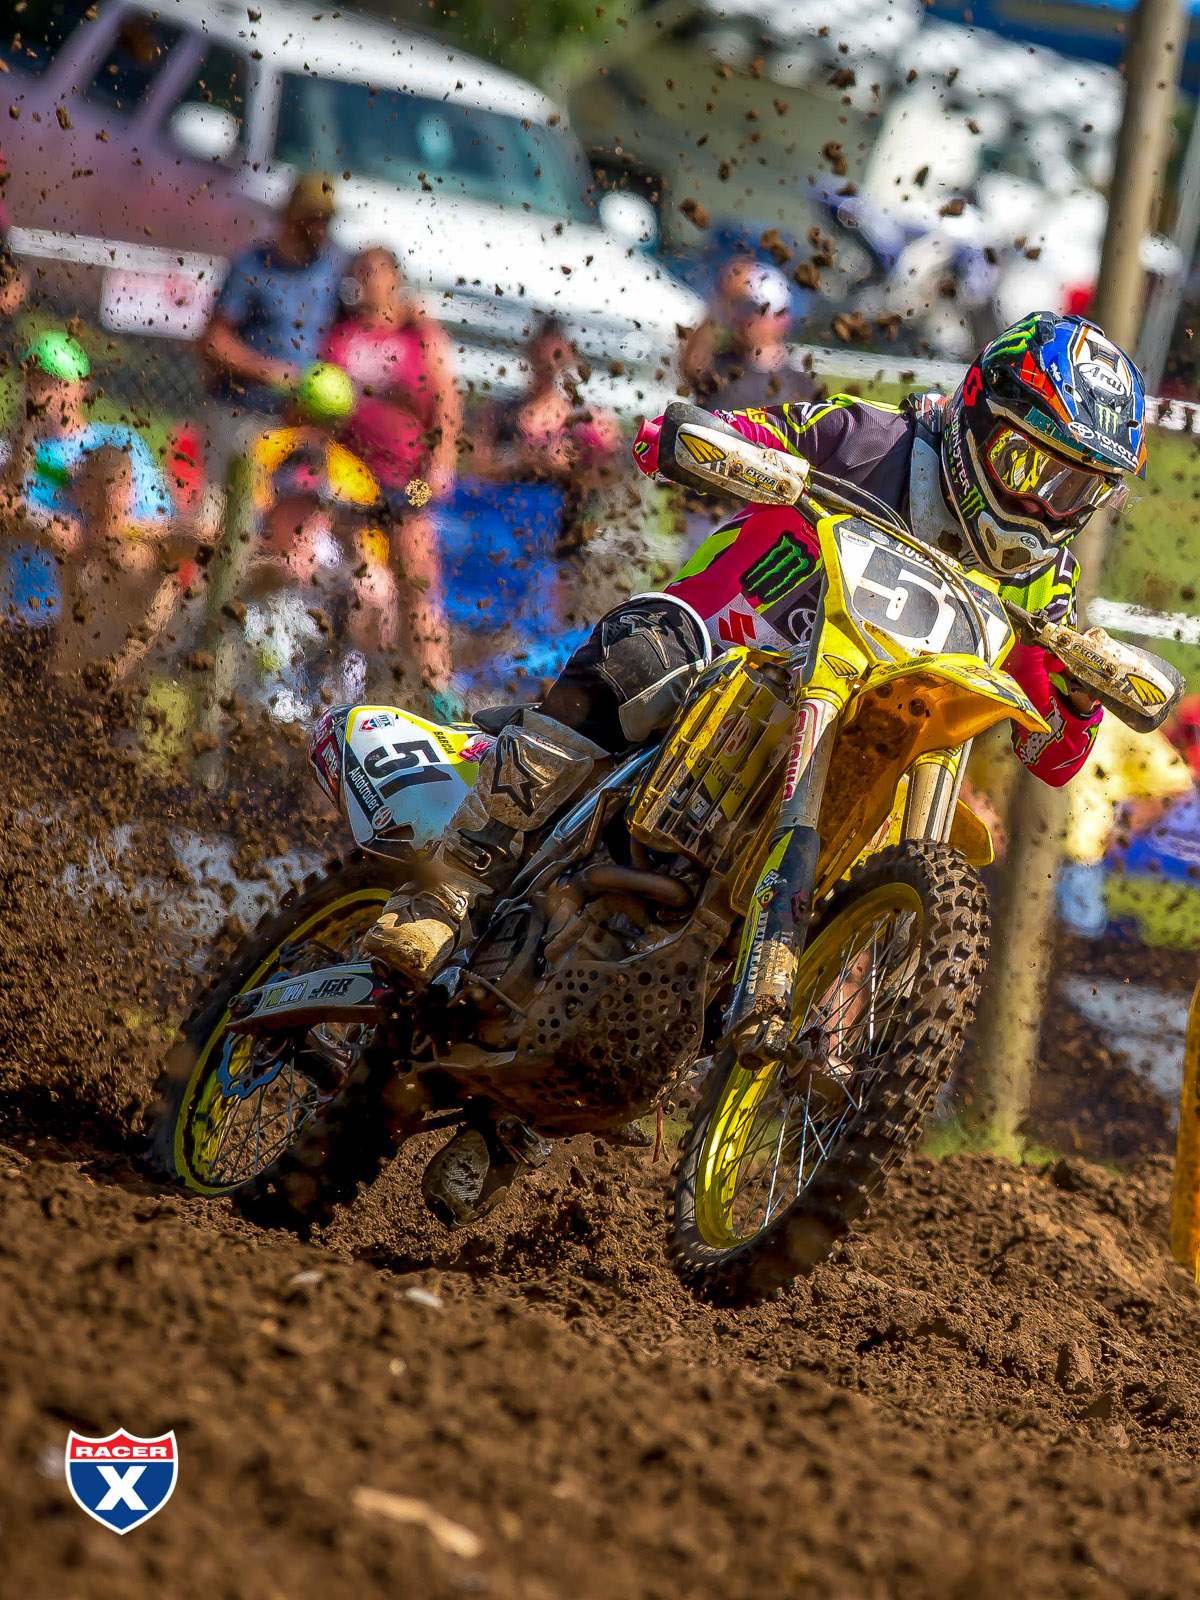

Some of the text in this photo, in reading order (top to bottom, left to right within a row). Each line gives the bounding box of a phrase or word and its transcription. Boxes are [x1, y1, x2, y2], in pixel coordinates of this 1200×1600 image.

[1082, 364, 1122, 394] Arai
[1094, 431, 1140, 466] TOYOTA
[746, 466, 778, 487] CYCRA
[1072, 644, 1105, 666] CYCRA
[433, 731, 457, 755] BARCIA
[363, 739, 453, 800] 51
[348, 766, 380, 812] Autotrader
[747, 911, 769, 995] DUNLOP
[311, 977, 355, 995] JGR
